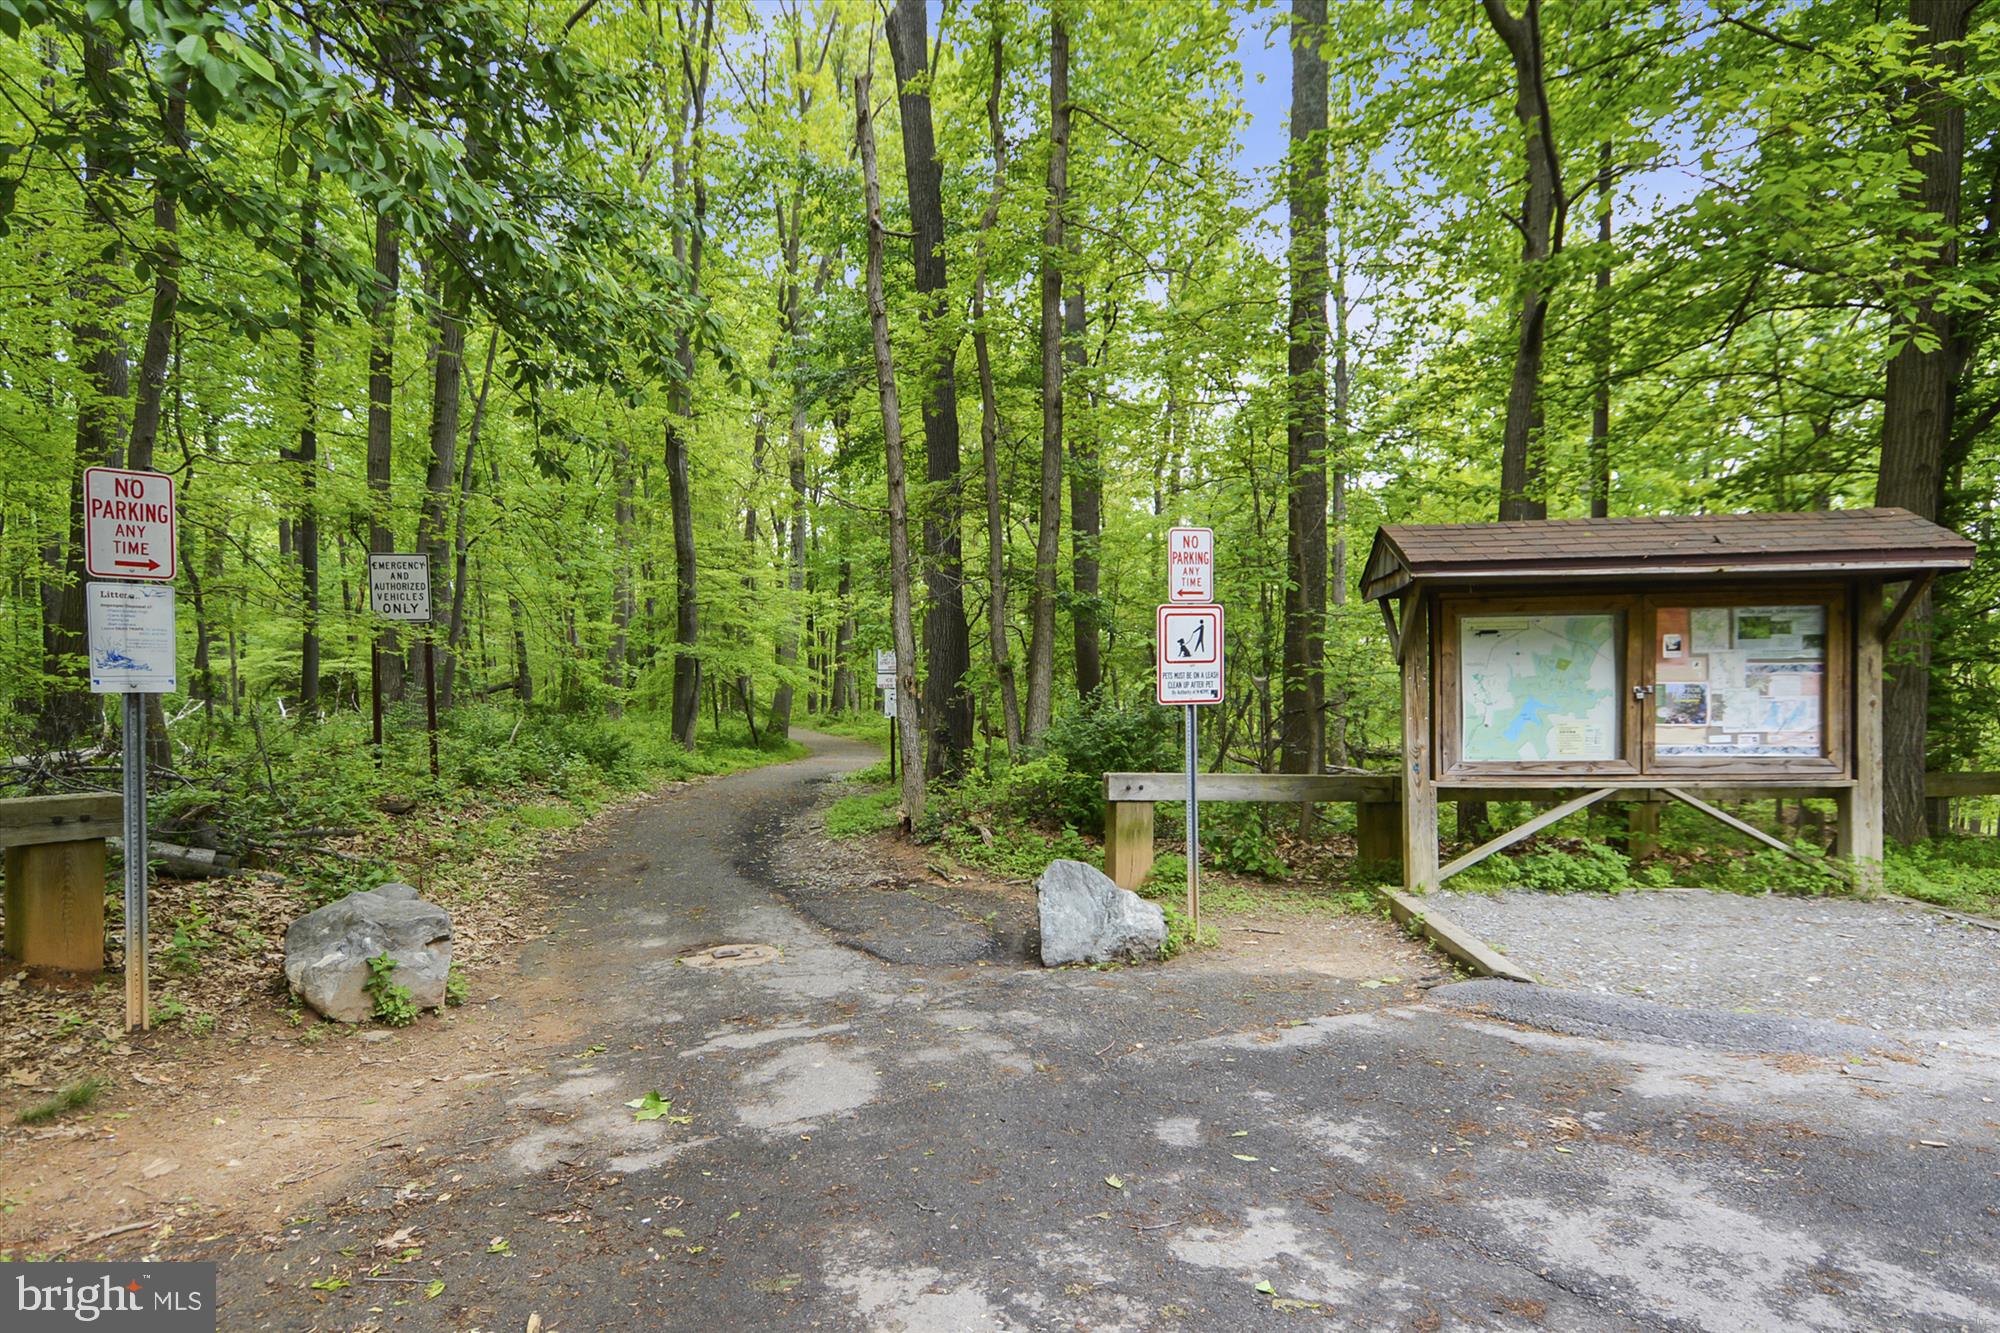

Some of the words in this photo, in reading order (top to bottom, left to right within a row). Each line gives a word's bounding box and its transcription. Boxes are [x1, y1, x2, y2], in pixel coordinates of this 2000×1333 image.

[114, 477, 145, 499] NO
[92, 498, 168, 524] PARKING
[115, 523, 146, 538] ANY
[1183, 535, 1199, 549] NO
[113, 540, 150, 556] TIME
[1172, 551, 1209, 565] PARKING
[372, 561, 425, 570] EMERGENCY
[390, 572, 409, 580] AND
[1183, 567, 1200, 576] ANY
[374, 582, 426, 591] AUTHORIZED
[1181, 577, 1202, 587] TIME
[377, 592, 424, 601] VEHICLES
[382, 603, 419, 614] ONLY
[1162, 671, 1174, 679] PETS
[1174, 671, 1186, 679] MUST
[1186, 671, 1193, 679] BE
[1193, 671, 1200, 679] ON
[1200, 671, 1204, 679] A
[1205, 671, 1219, 679] LEASH
[1167, 680, 1182, 689] CLEAN
[1183, 681, 1190, 689] UP
[1190, 680, 1204, 689] AFTER
[1205, 680, 1214, 689] PET
